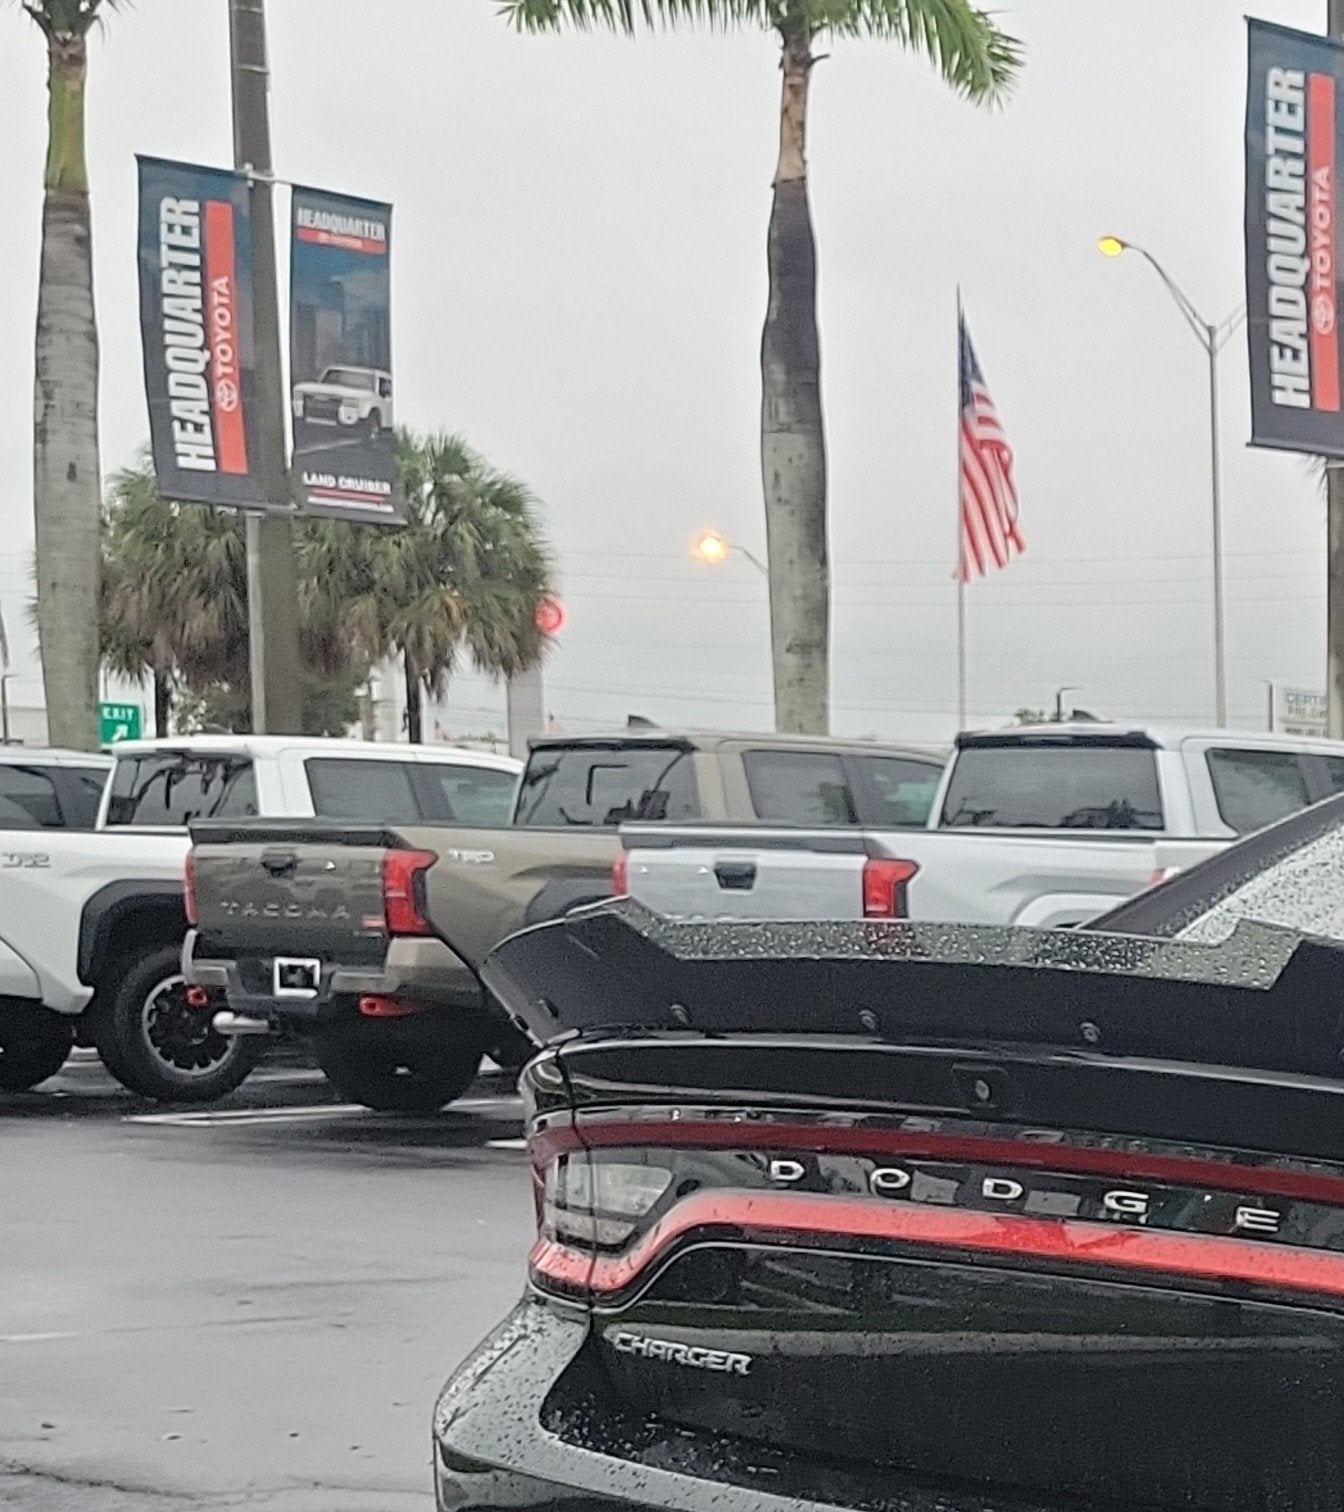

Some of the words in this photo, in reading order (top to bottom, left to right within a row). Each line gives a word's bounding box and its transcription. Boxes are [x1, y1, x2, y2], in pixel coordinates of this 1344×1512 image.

[296, 205, 386, 240] HEADQUARTER
[1265, 65, 1311, 410] HEADQUARTER
[1310, 165, 1332, 290] TOYOTA
[160, 195, 217, 472] HEADQUARTER
[211, 275, 235, 378] TOYOTA
[303, 471, 337, 489] LAND
[338, 475, 392, 495] CRUISER
[102, 706, 135, 721] EXIT
[220, 900, 351, 920] TACOMA
[770, 1159, 1281, 1233] DODGE
[613, 1331, 753, 1376] CHARGER
